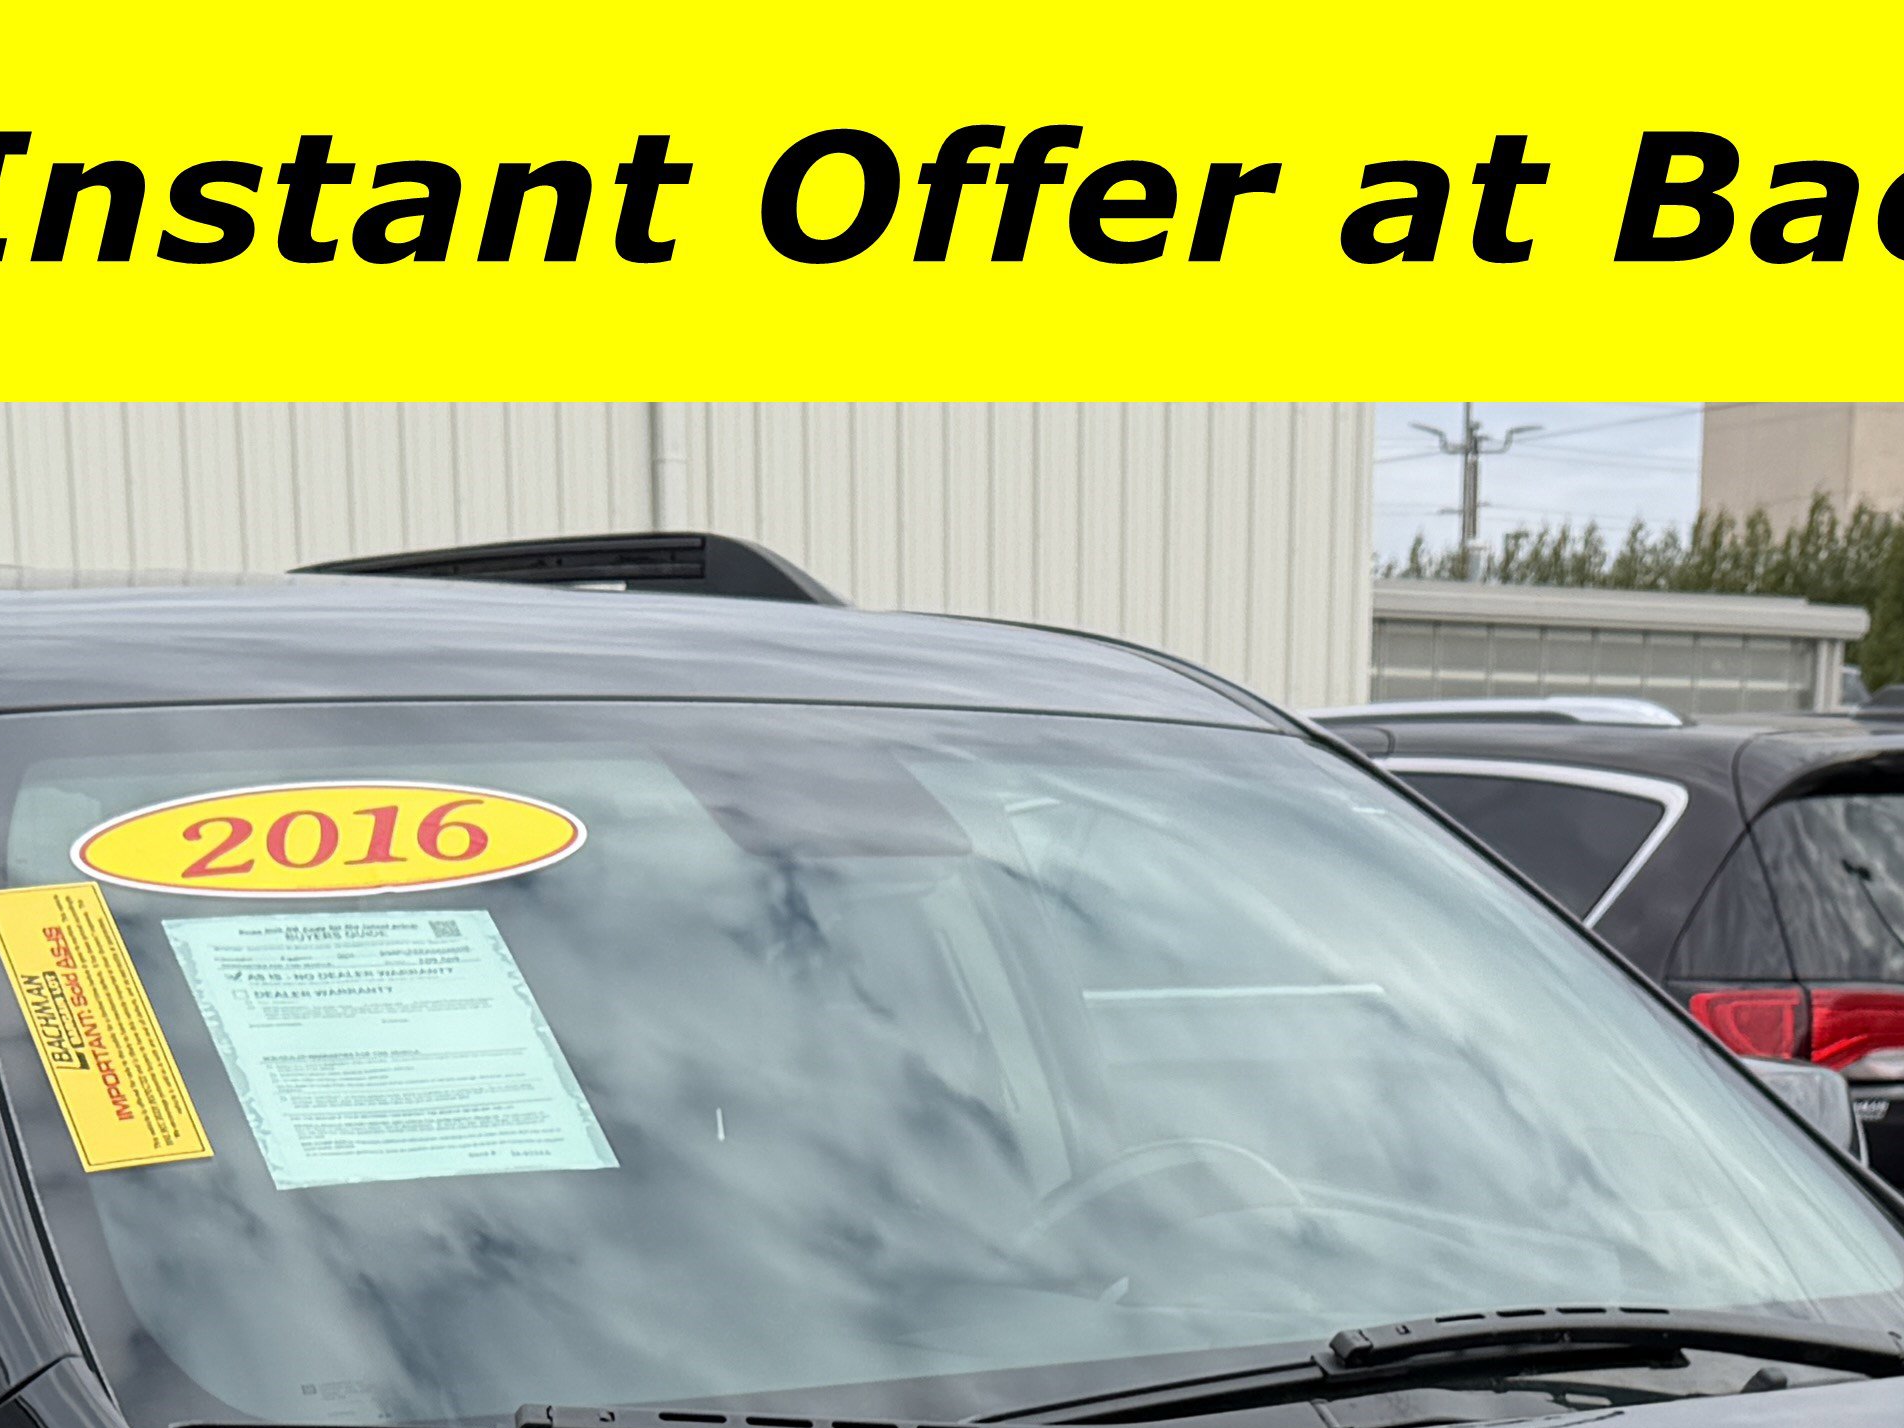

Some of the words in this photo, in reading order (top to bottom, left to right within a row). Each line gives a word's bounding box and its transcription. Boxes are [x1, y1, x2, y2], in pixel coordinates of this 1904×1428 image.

[181, 800, 489, 879] 2016
[61, 973, 88, 1006] Sold
[254, 990, 311, 999] DEALER
[315, 986, 393, 997] WARRANTY
[318, 970, 373, 980] DEALER
[377, 967, 453, 978] WARRANTY
[21, 974, 74, 1064] BACHMAN
[77, 1009, 134, 1120] IMPORTANT:
